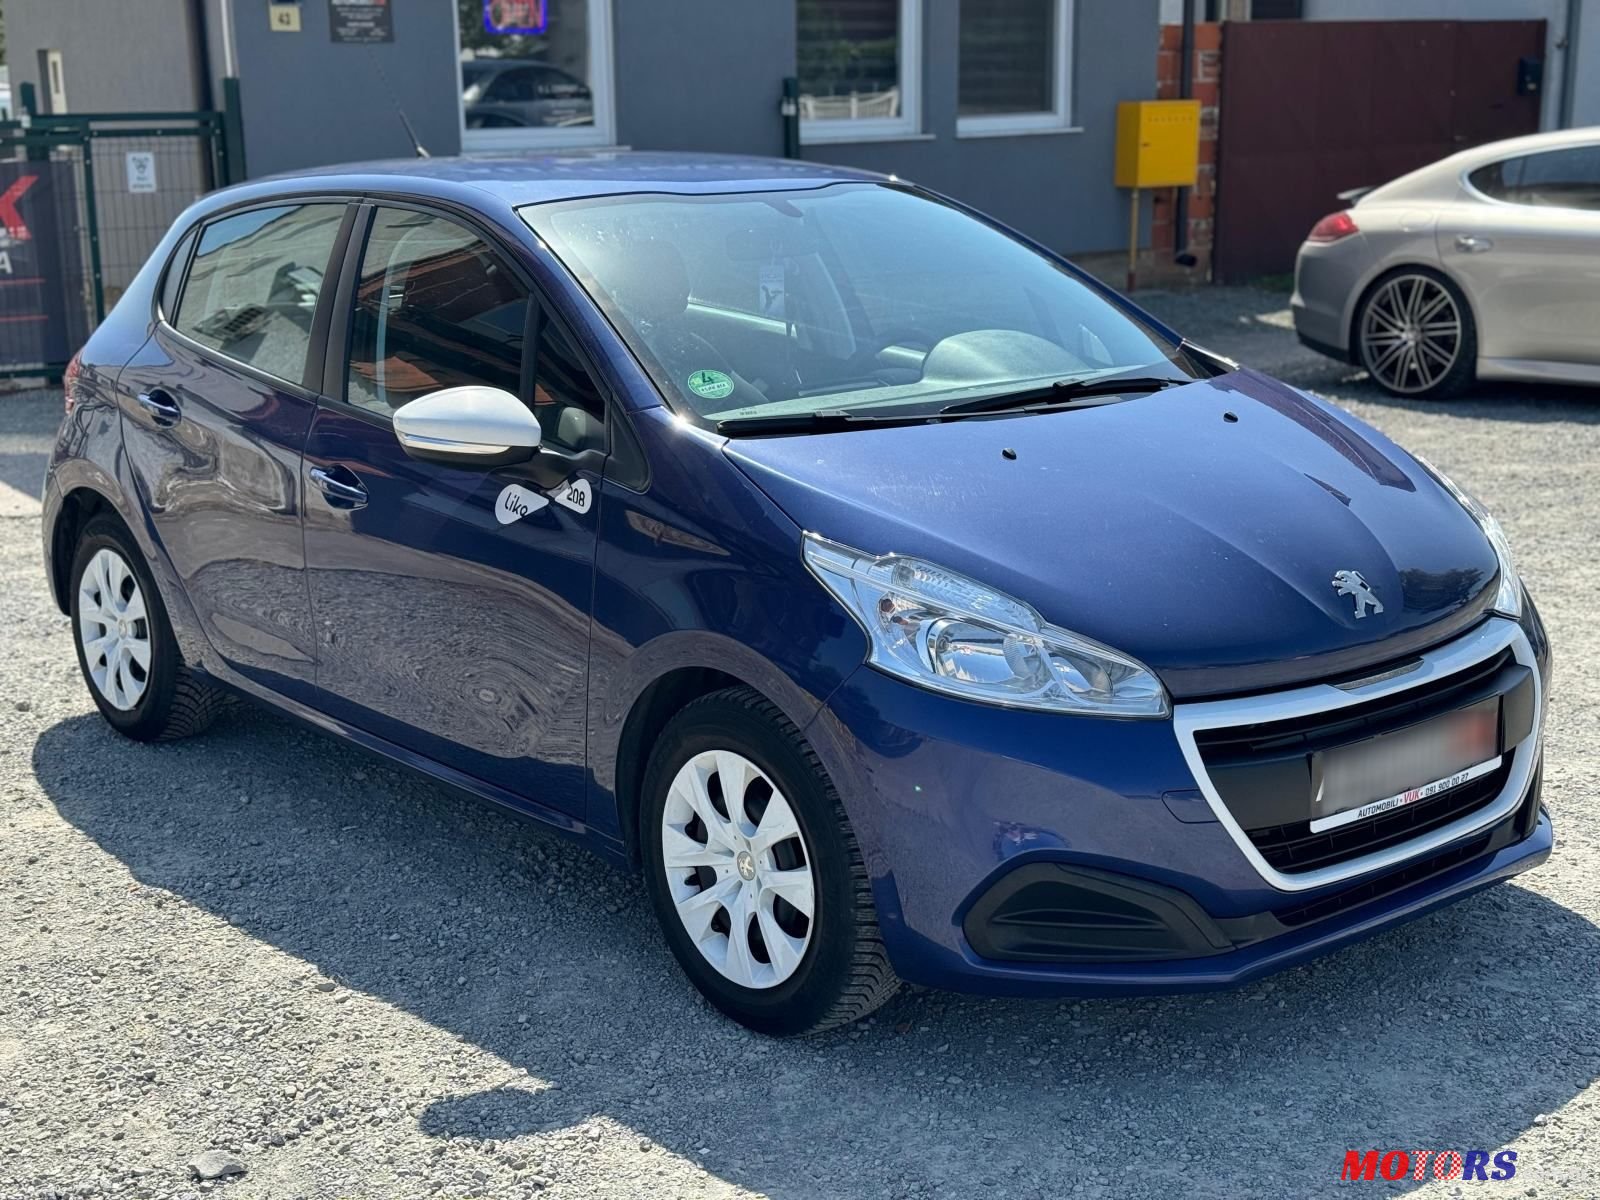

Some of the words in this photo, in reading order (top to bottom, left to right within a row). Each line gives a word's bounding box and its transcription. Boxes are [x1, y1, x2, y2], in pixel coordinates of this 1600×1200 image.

[566, 485, 586, 507] 208
[1357, 797, 1399, 818] AUTOMOBILI
[1403, 789, 1421, 804] VUK
[1425, 785, 1437, 796] 091
[1460, 772, 1469, 783] 27
